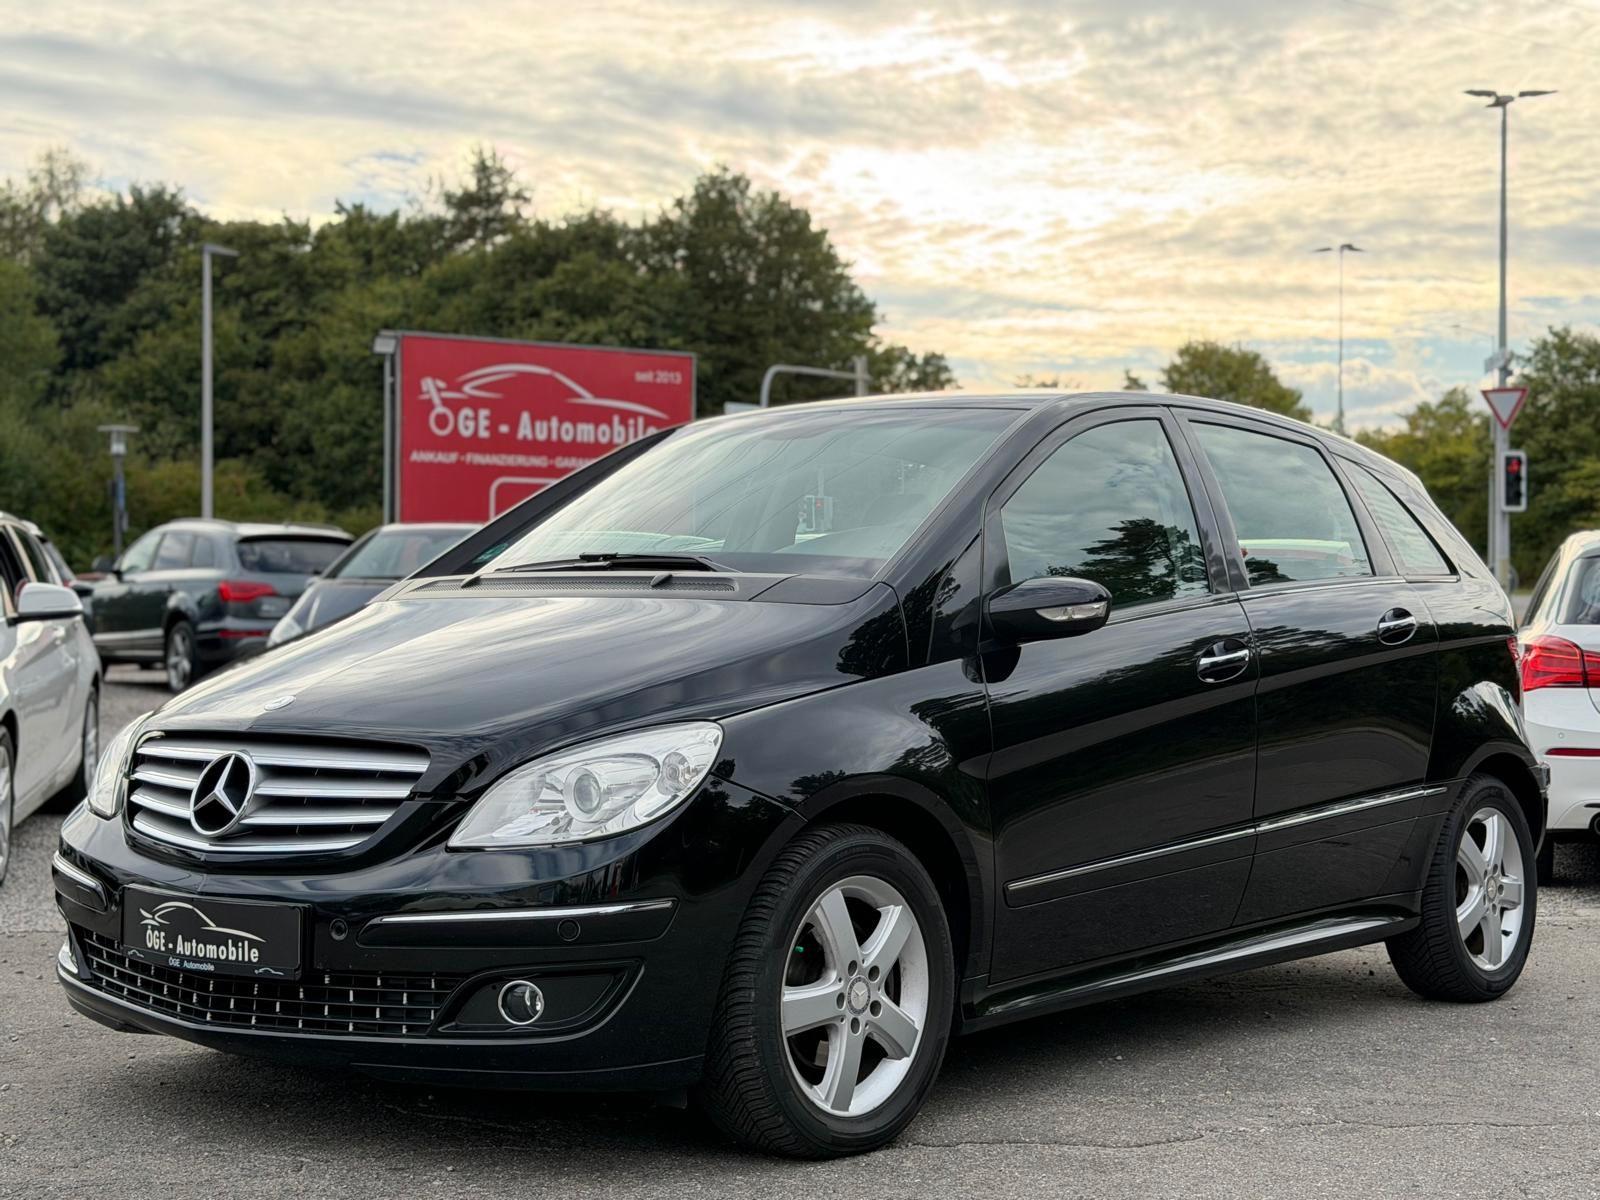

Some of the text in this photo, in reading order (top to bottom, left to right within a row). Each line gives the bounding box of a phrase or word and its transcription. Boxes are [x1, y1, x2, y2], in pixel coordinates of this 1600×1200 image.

[655, 370, 683, 385] 2013
[410, 450, 459, 464] ANKAUF
[465, 452, 549, 468] FINANZIERUNG
[176, 934, 259, 963] Automobile
[183, 960, 215, 971] Automobile
